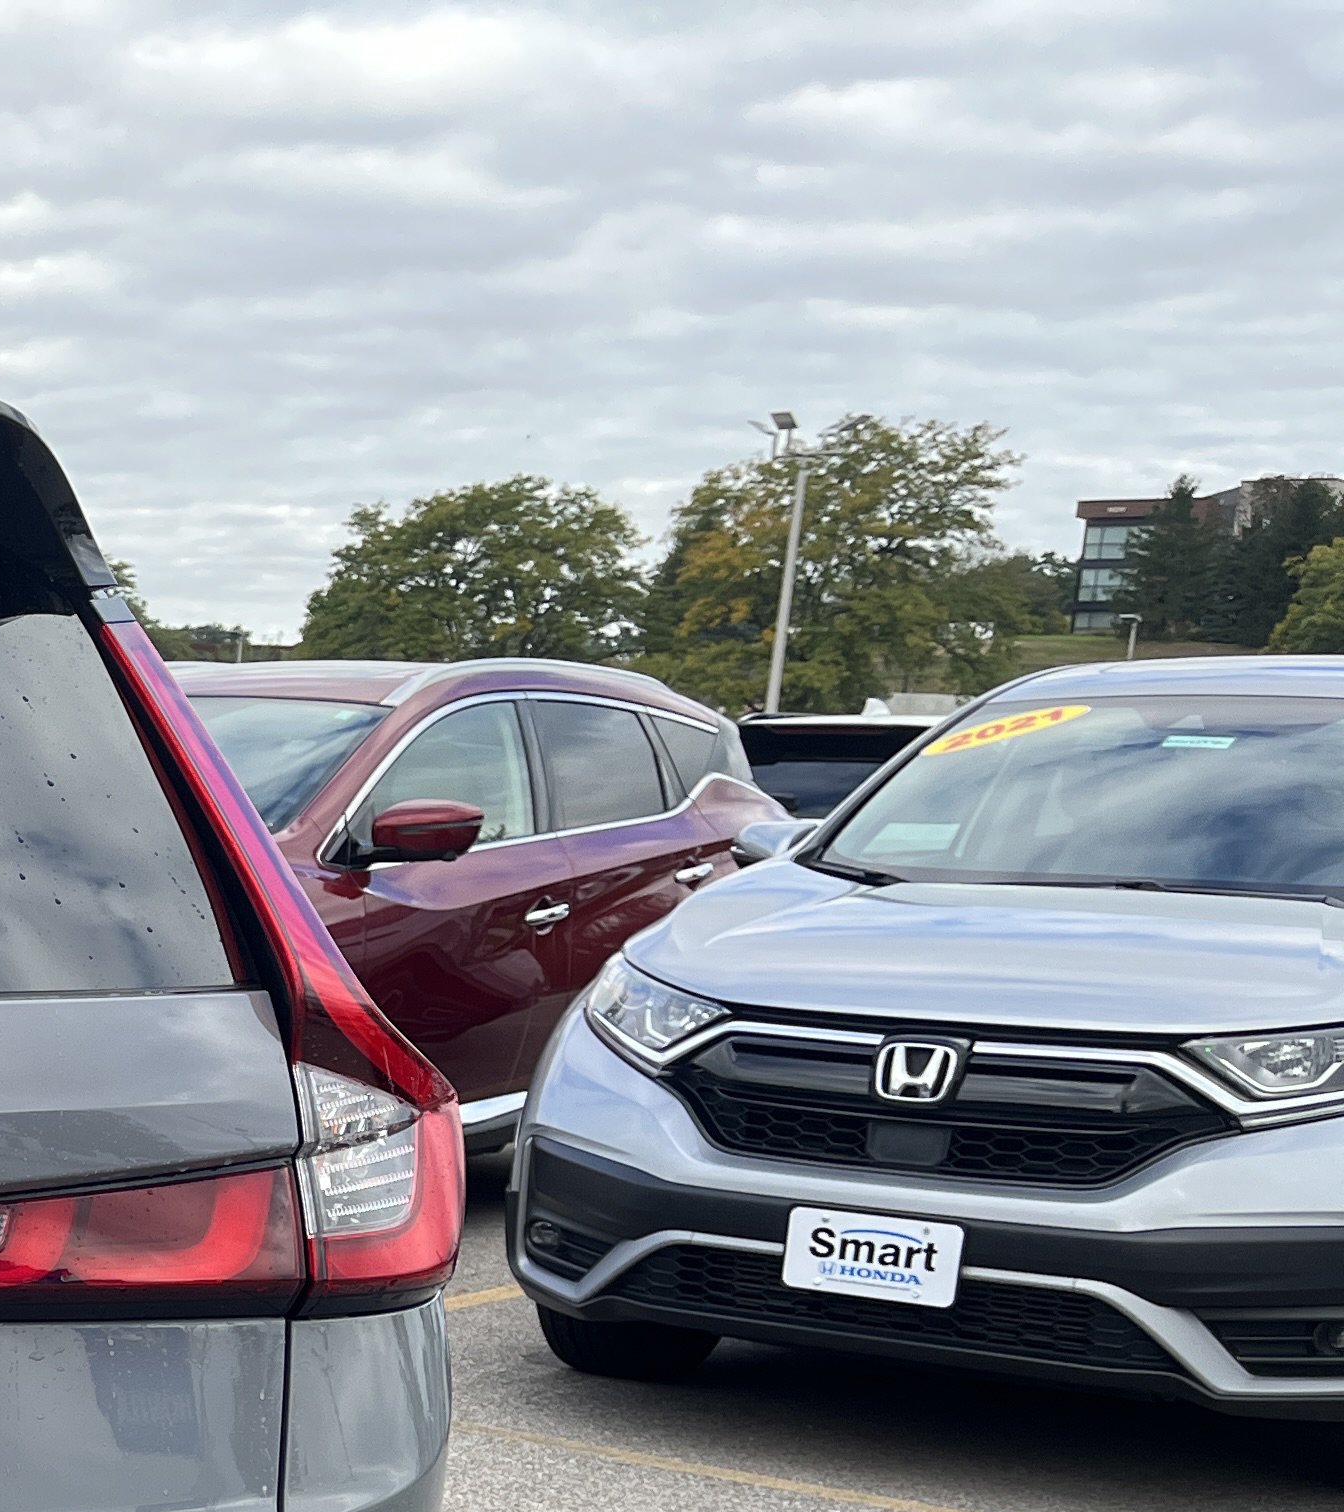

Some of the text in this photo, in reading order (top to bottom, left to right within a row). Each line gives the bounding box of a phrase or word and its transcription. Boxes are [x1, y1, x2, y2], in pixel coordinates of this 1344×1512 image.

[943, 708, 1063, 751] 2021
[809, 1227, 938, 1272] Smart
[839, 1265, 923, 1285] HONDA
